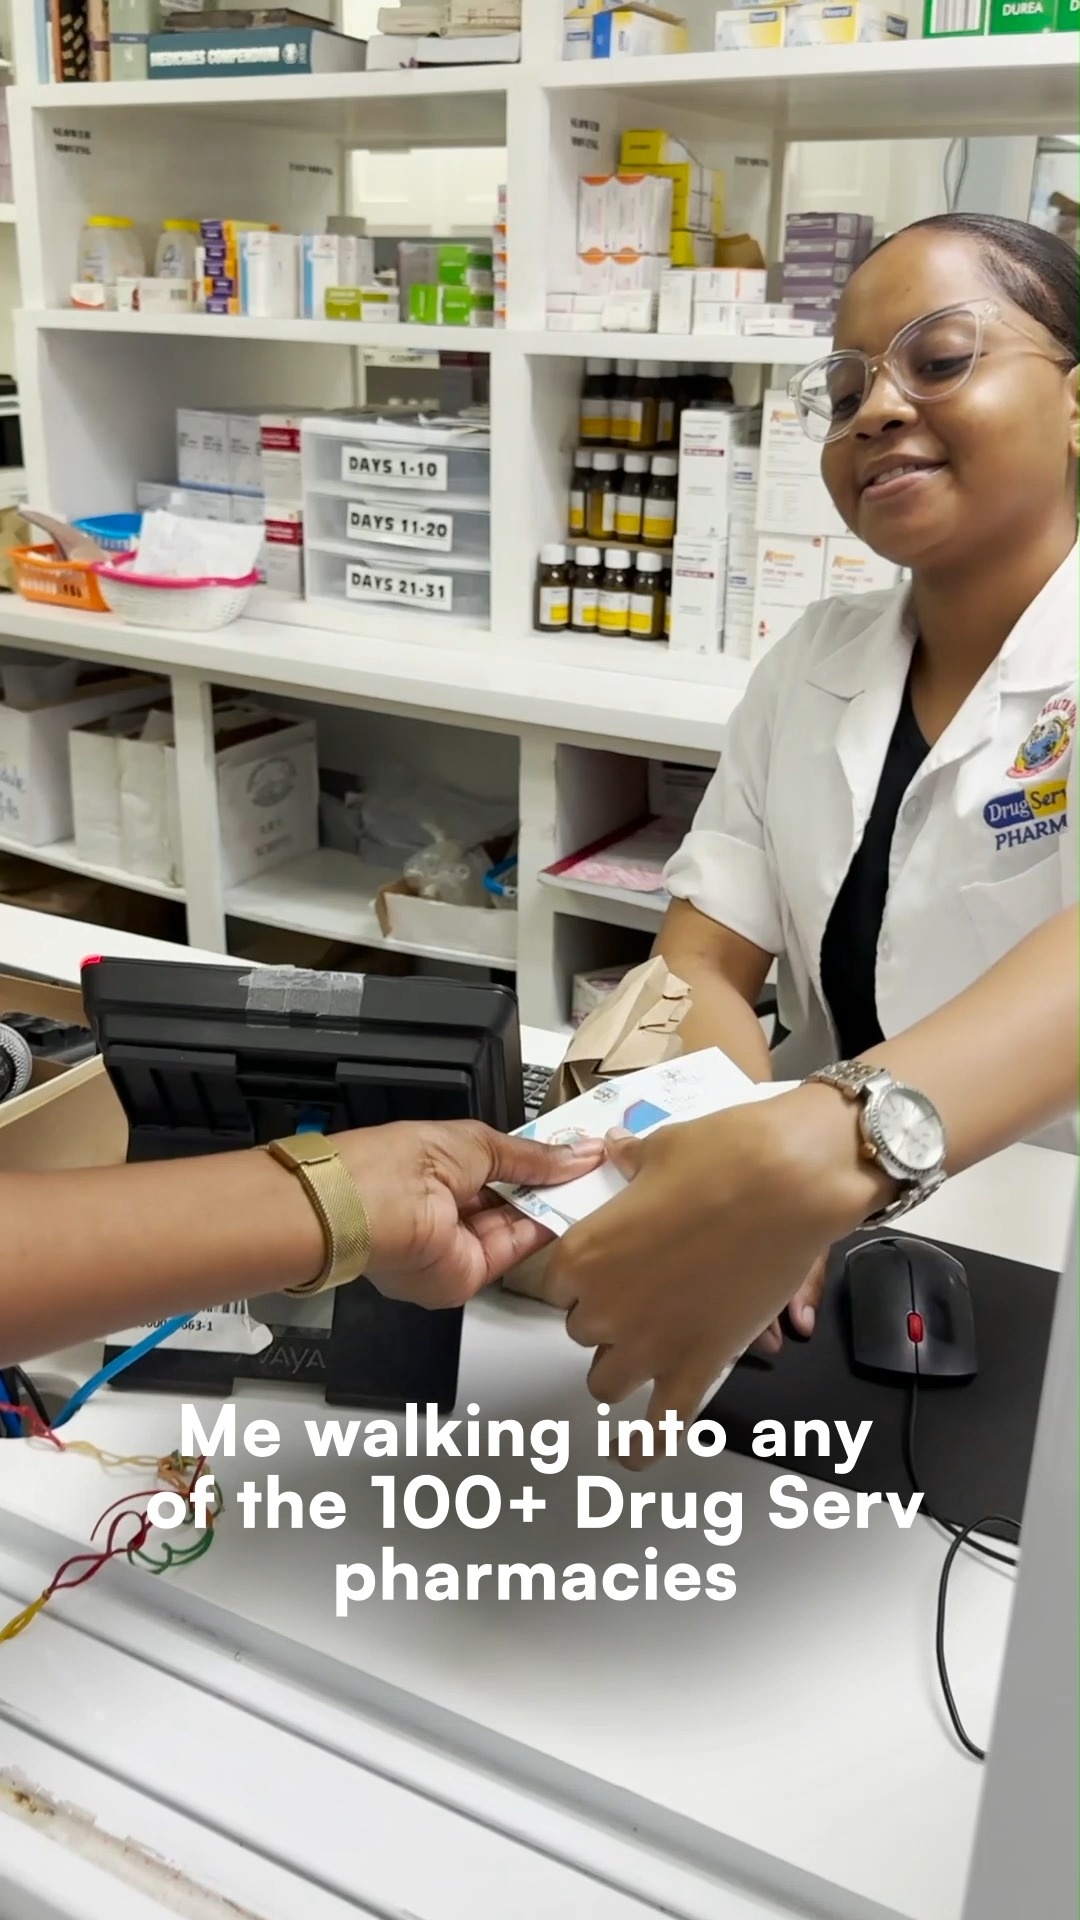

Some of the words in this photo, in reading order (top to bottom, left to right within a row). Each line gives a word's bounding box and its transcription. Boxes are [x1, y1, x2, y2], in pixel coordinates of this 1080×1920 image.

[1002, 1, 1044, 16] DUREA
[349, 456, 392, 474] DAYS
[351, 512, 394, 531] DAYS
[351, 572, 394, 592] DAYS
[987, 799, 1030, 822] Drug
[234, 1345, 326, 1375] VAYA
